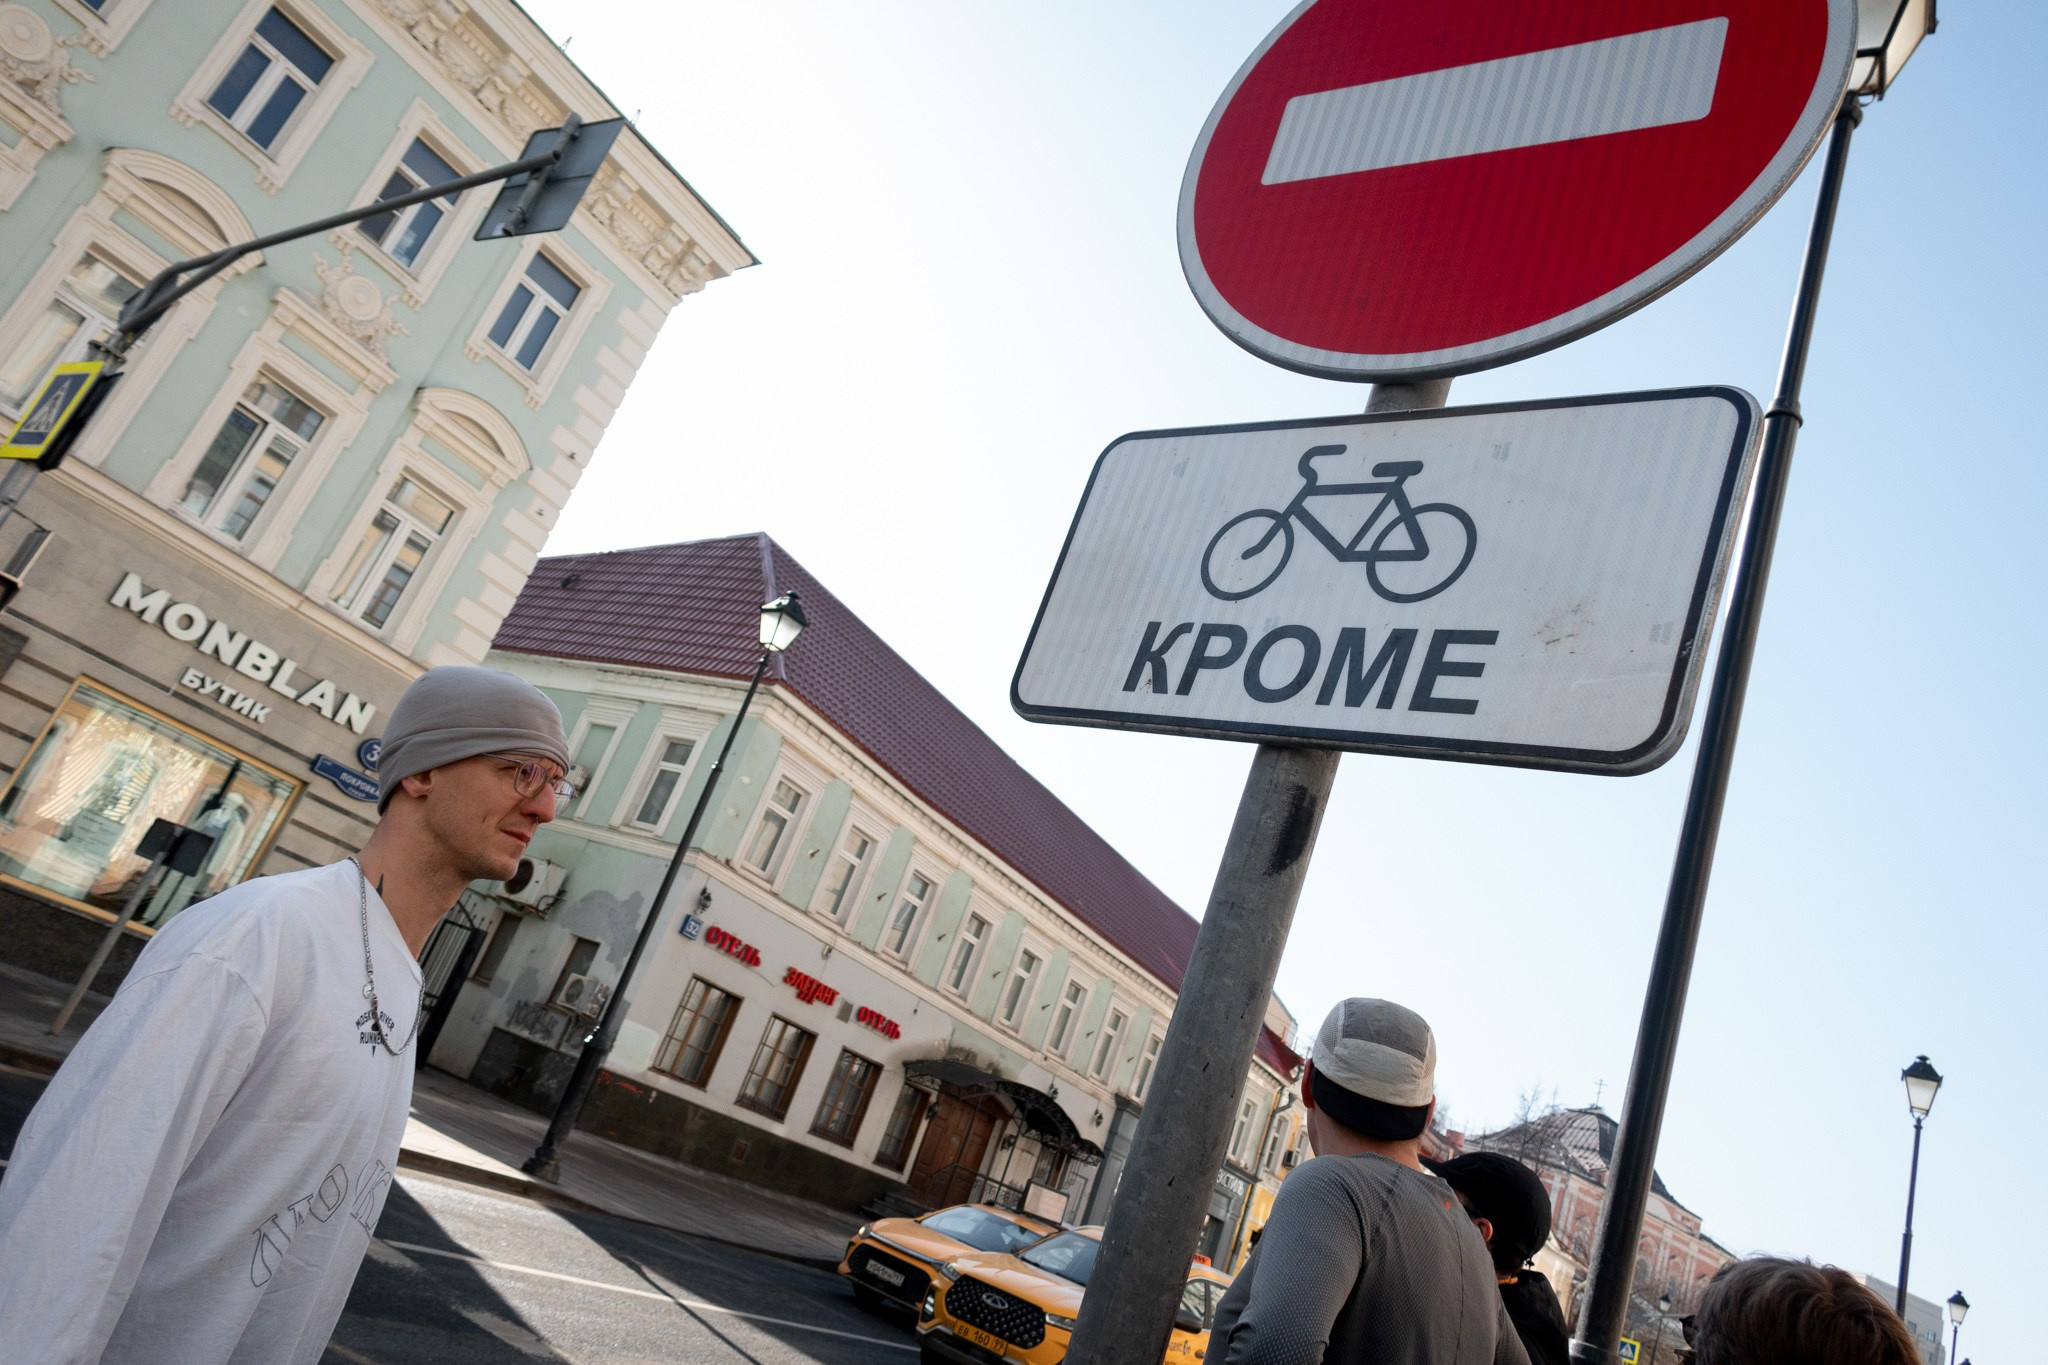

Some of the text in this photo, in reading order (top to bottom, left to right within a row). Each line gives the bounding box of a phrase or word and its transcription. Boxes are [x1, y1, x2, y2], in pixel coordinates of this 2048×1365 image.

[110, 572, 377, 735] MONBLAN
[1122, 621, 1500, 715] КРОМЕ
[180, 667, 272, 724] БУТИК
[687, 921, 700, 935] 32
[705, 926, 901, 1040] ОТЕЛЬ ЭЛЕГАНТ ОТЕЛЬ
[360, 1032, 388, 1045] RUNNE
[380, 1011, 395, 1032] RIVER
[974, 1330, 990, 1346] 160
